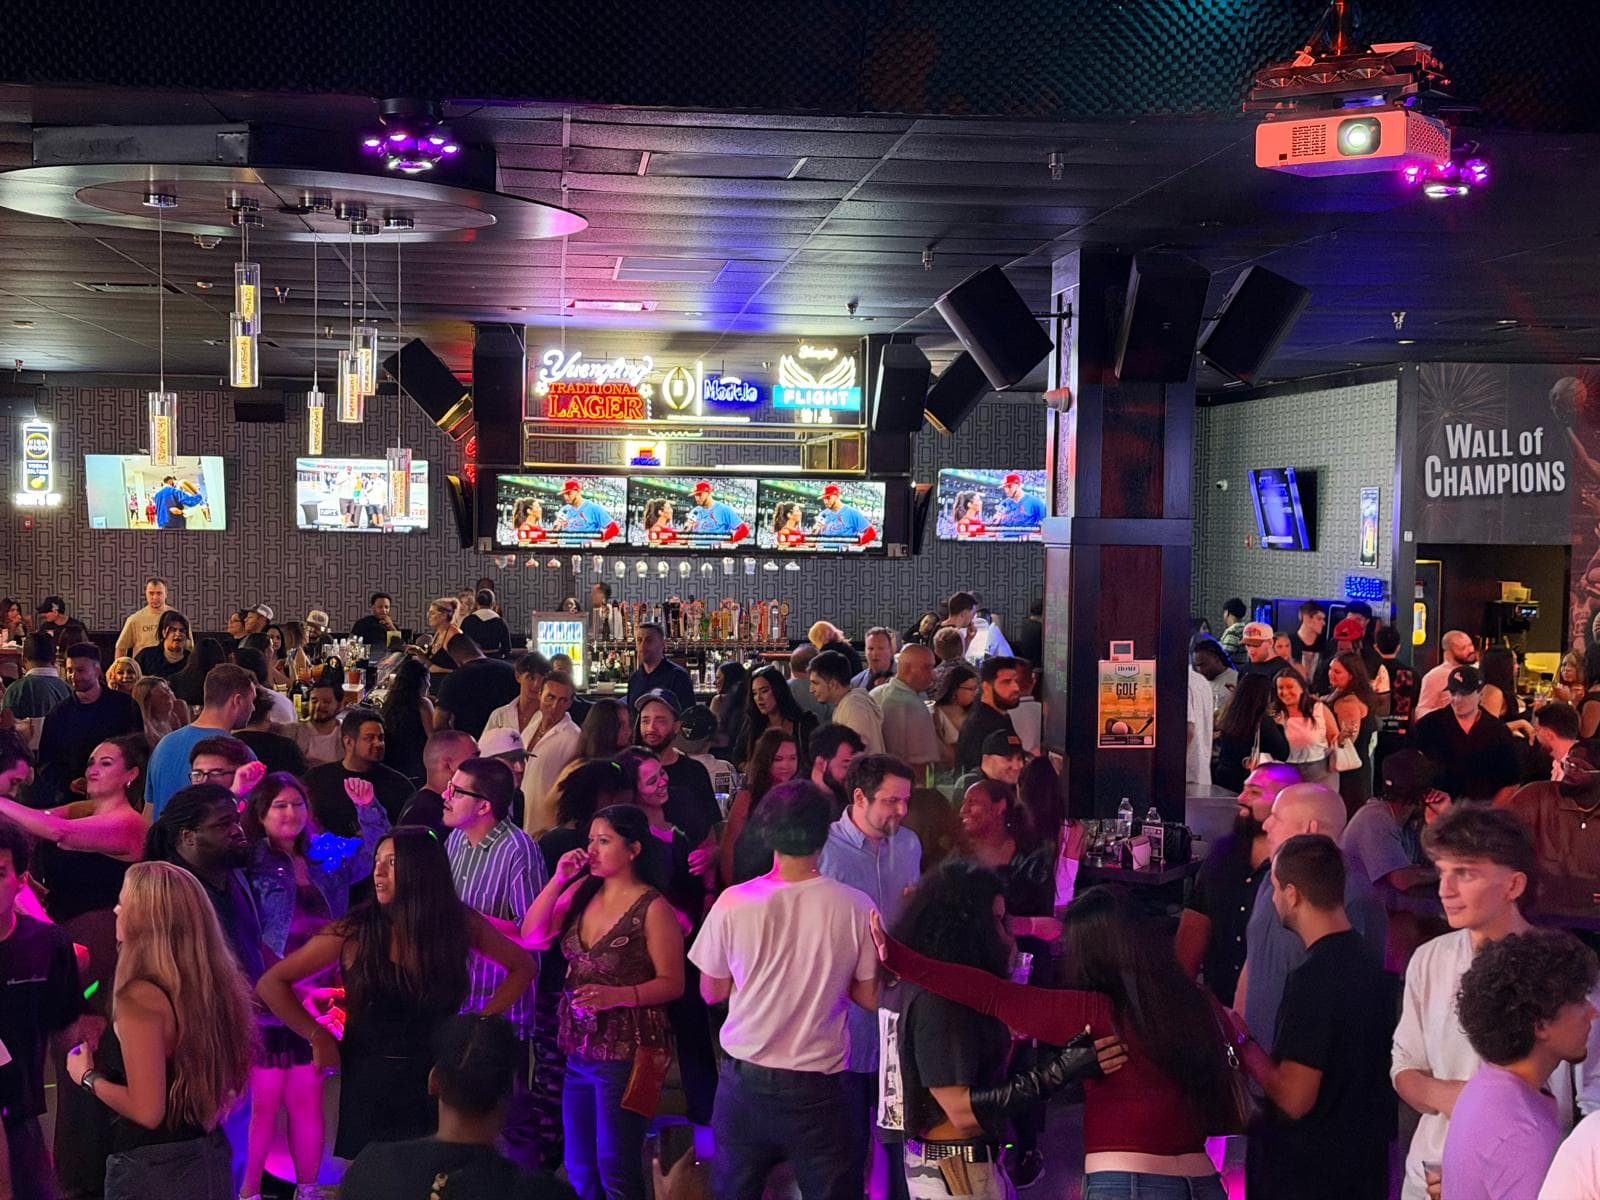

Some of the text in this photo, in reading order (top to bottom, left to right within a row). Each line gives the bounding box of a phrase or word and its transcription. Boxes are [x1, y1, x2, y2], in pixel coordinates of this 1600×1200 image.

[540, 349, 653, 386] Yuengling
[704, 378, 758, 402] Modelo
[784, 390, 848, 406] FLIGHT
[548, 395, 643, 419] LAGER
[1446, 424, 1543, 459] WALL of
[1425, 455, 1565, 498] CHAMPIONS
[1116, 682, 1138, 696] GOLF
